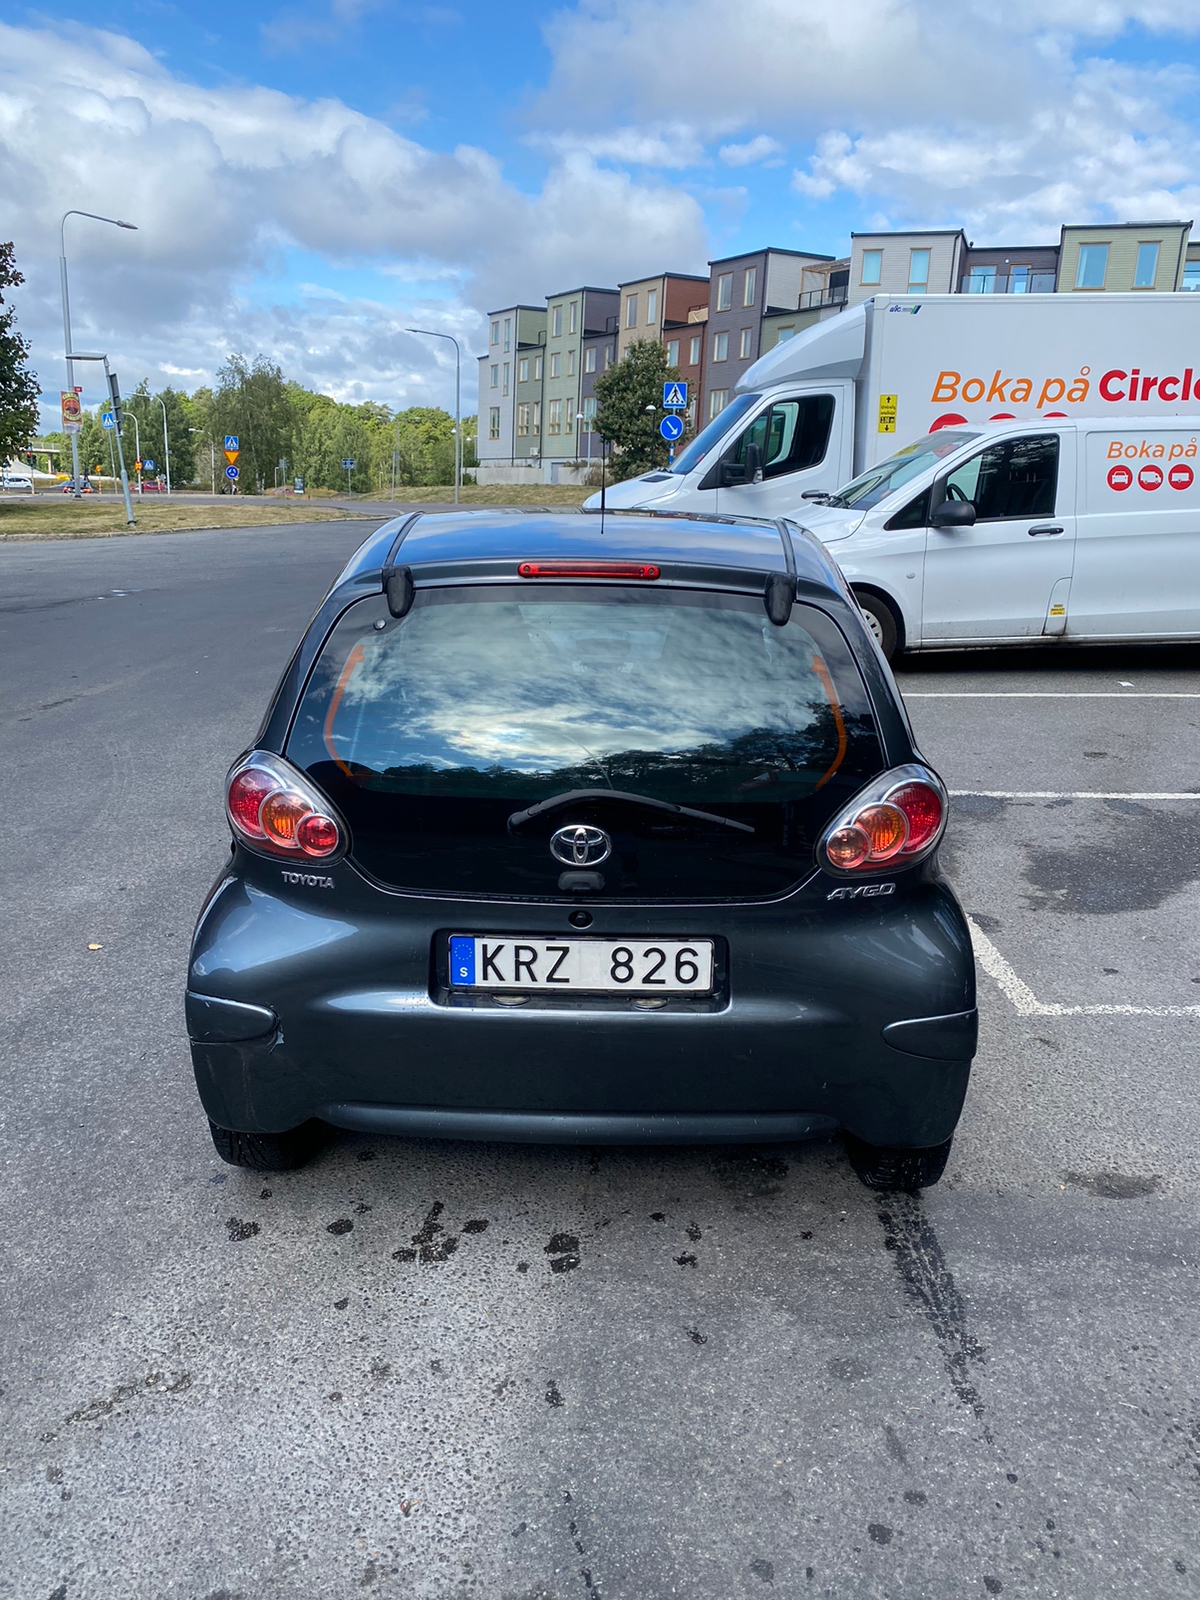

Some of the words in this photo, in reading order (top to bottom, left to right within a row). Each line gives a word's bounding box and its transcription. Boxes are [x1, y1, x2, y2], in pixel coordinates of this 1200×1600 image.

[931, 370, 1034, 403] Boka
[1036, 366, 1091, 409] på
[1106, 440, 1165, 459] Boka
[1167, 437, 1198, 461] på
[281, 870, 335, 889] TOYOTA
[826, 882, 896, 901] AYGO
[459, 966, 468, 977] S
[482, 943, 570, 983] KRZ
[610, 946, 699, 985] 826
